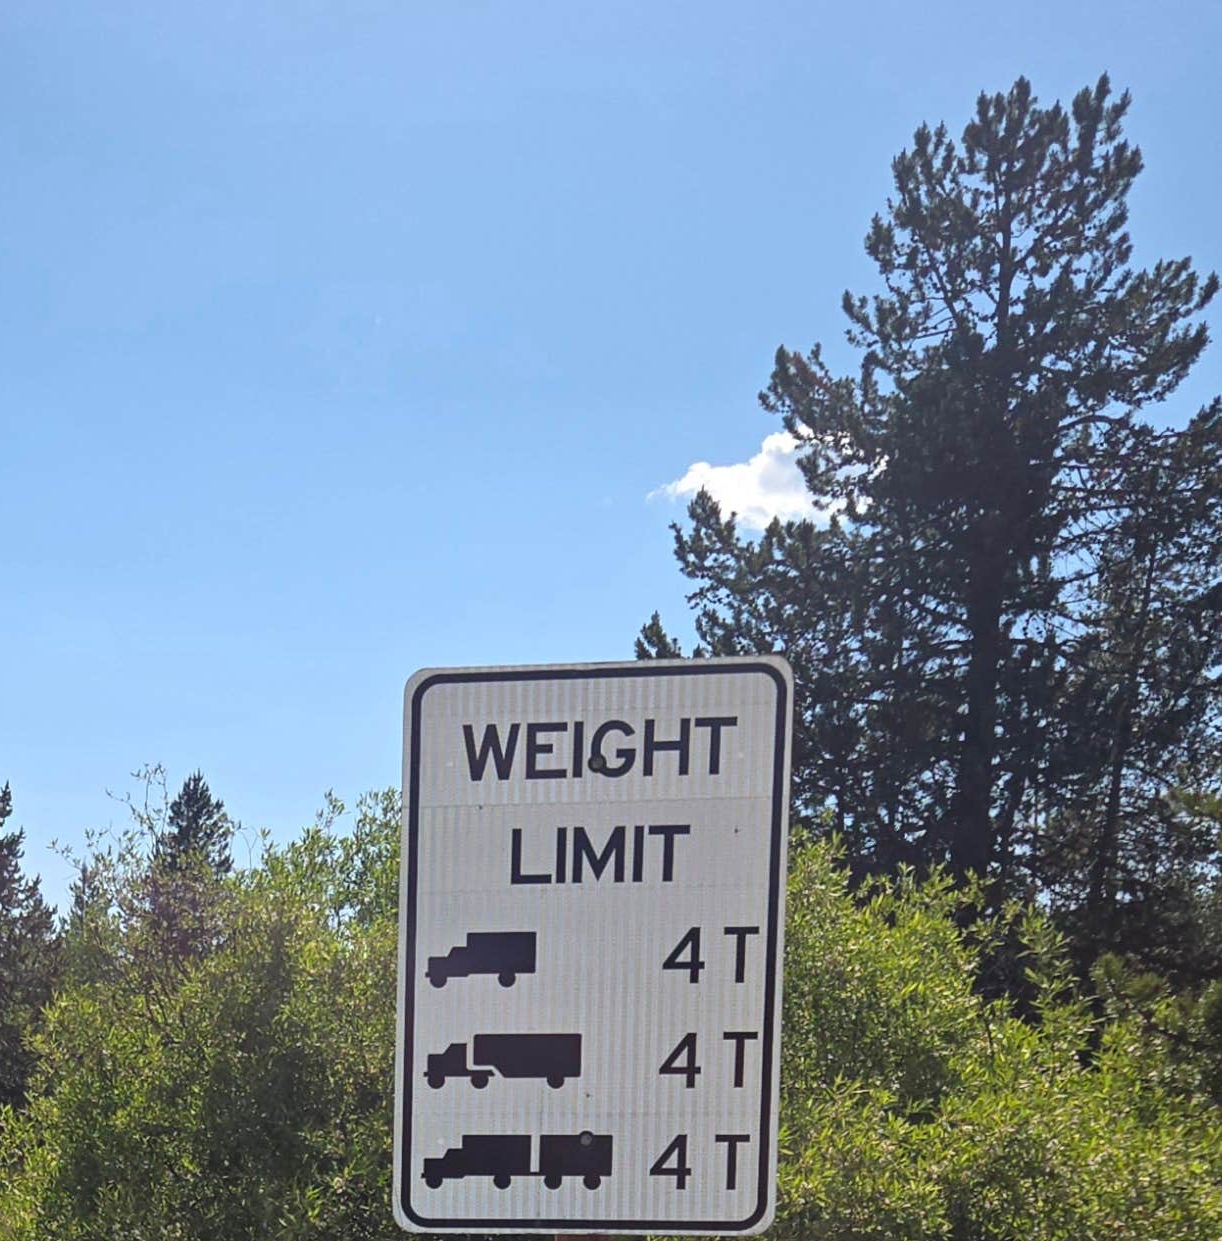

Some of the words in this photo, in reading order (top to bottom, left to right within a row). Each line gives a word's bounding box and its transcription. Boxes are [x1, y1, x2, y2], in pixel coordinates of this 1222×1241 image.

[462, 716, 739, 782] WEIGHT
[510, 824, 691, 885] LIMIT
[661, 926, 706, 984] 4
[723, 925, 760, 984] T
[658, 1032, 702, 1089] 4
[722, 1031, 759, 1089] T
[649, 1133, 692, 1190] 4
[714, 1133, 751, 1191] T
